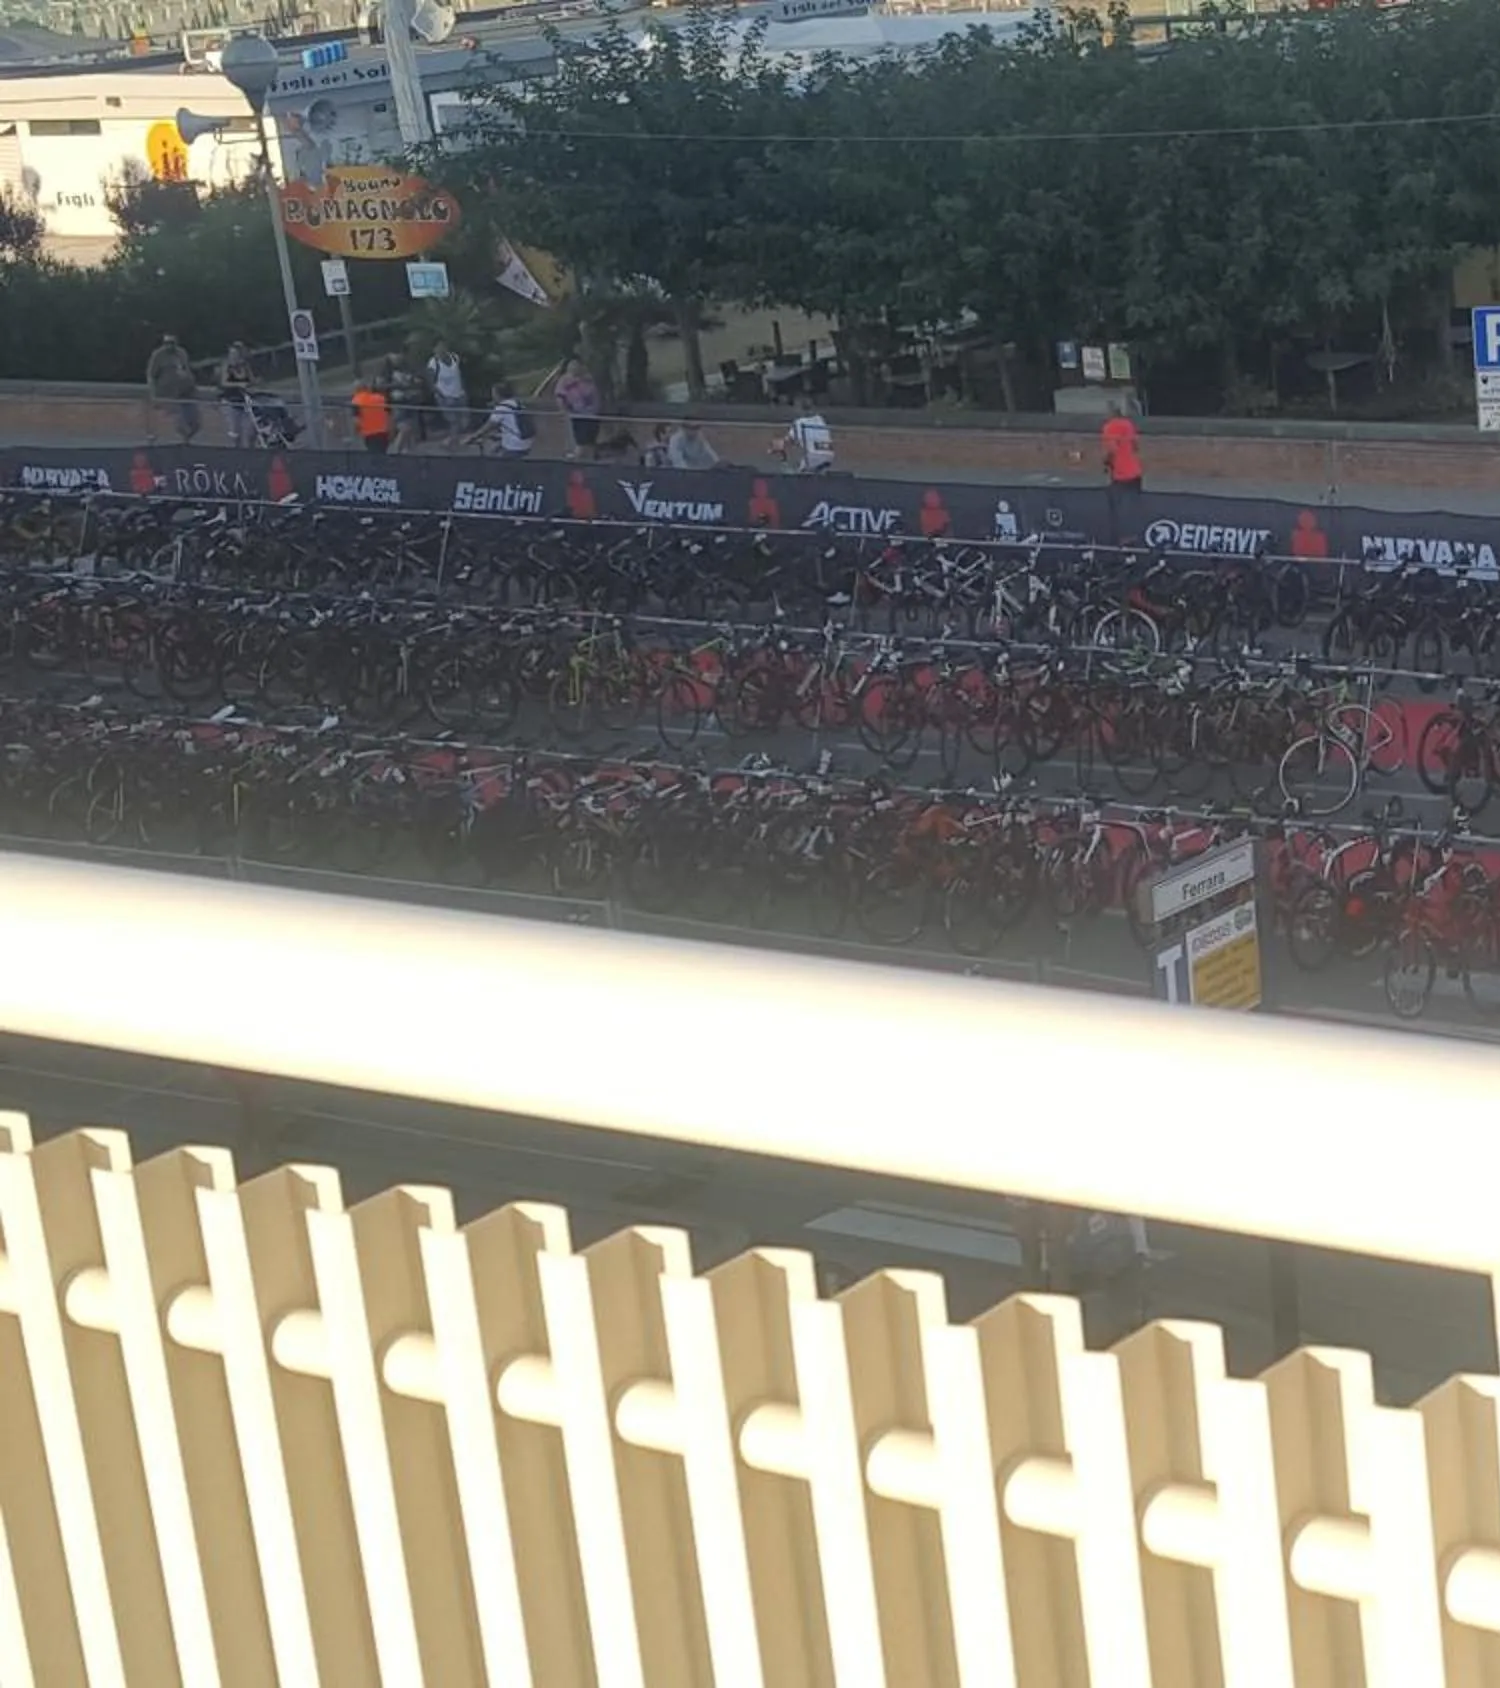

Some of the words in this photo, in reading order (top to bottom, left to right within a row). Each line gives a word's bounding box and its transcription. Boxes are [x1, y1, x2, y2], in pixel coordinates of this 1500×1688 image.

[353, 64, 390, 79] Sol
[56, 191, 95, 208] Figli
[349, 227, 397, 251] 173
[315, 475, 373, 501] HOKA
[453, 481, 545, 514] Santini
[802, 501, 900, 533] ACTIVE
[1181, 871, 1225, 900] Ferrara
